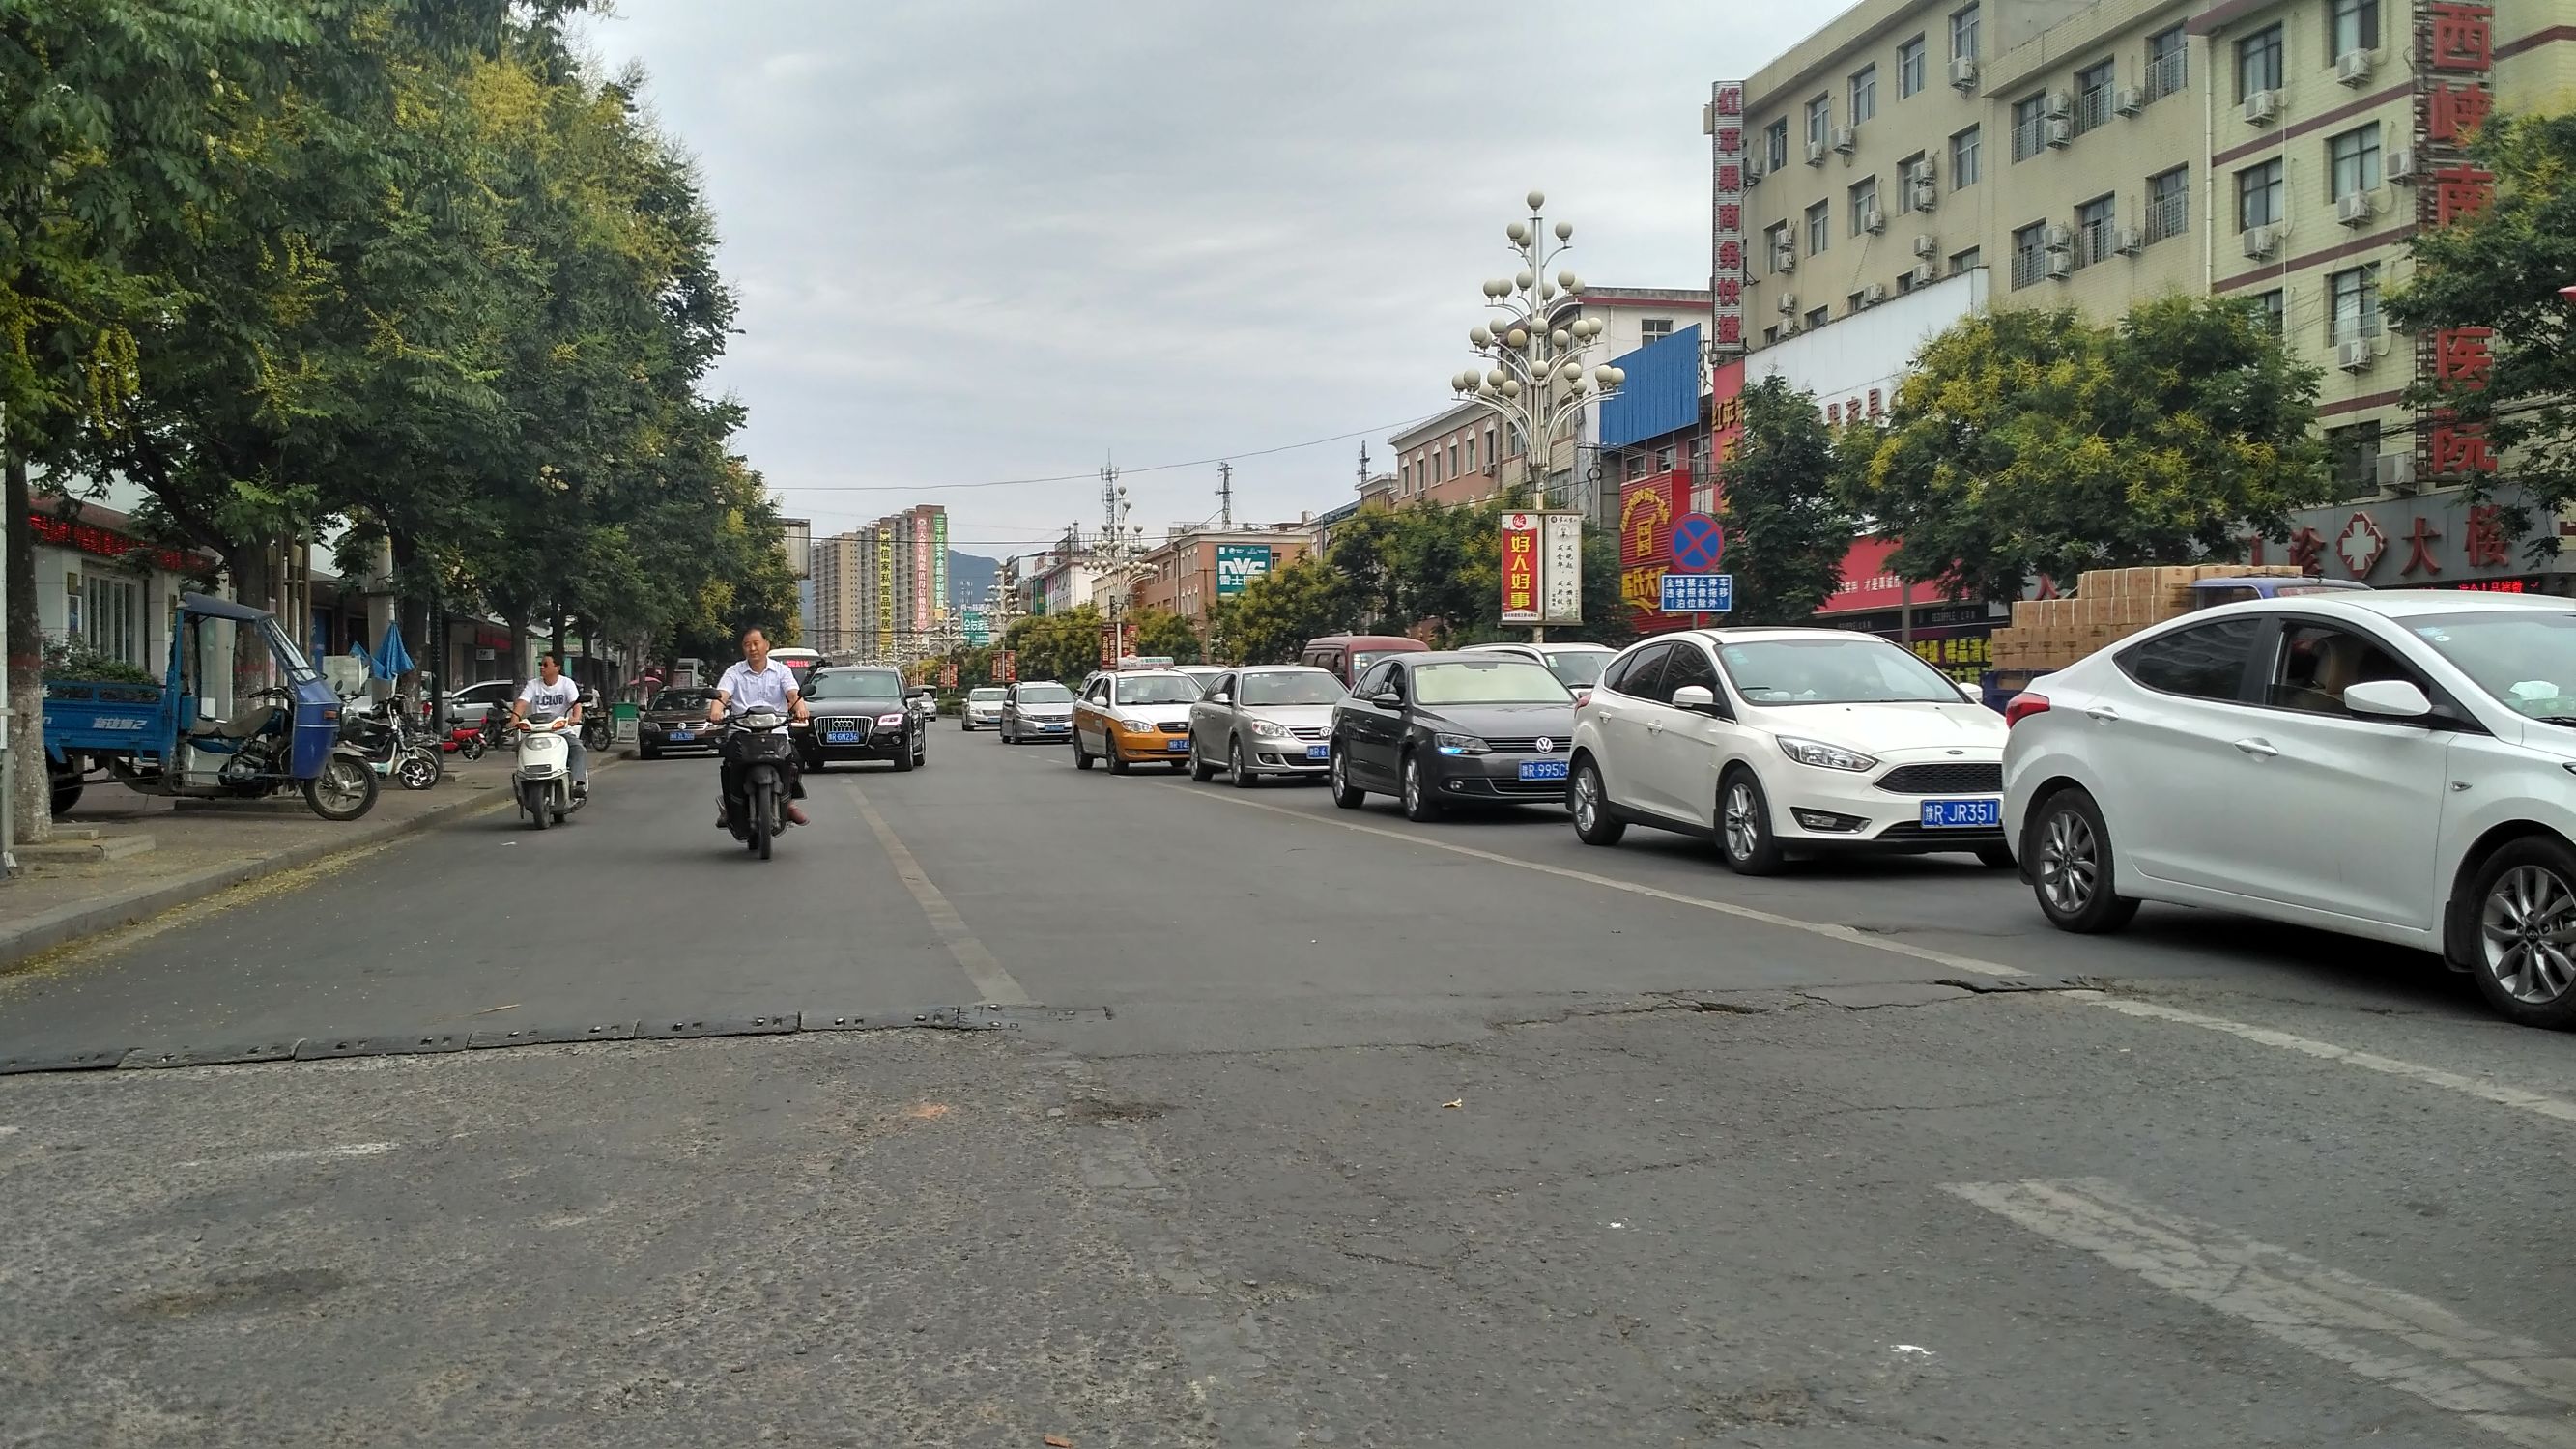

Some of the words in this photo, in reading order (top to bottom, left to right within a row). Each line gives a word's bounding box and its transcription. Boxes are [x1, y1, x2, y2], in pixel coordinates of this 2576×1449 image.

[1717, 87, 1740, 344] 红苹果商务快捷
[1510, 536, 1531, 608] 好人好事
[1665, 578, 1729, 588] 全线禁止停车
[1665, 588, 1729, 598] 违者照像拖移
